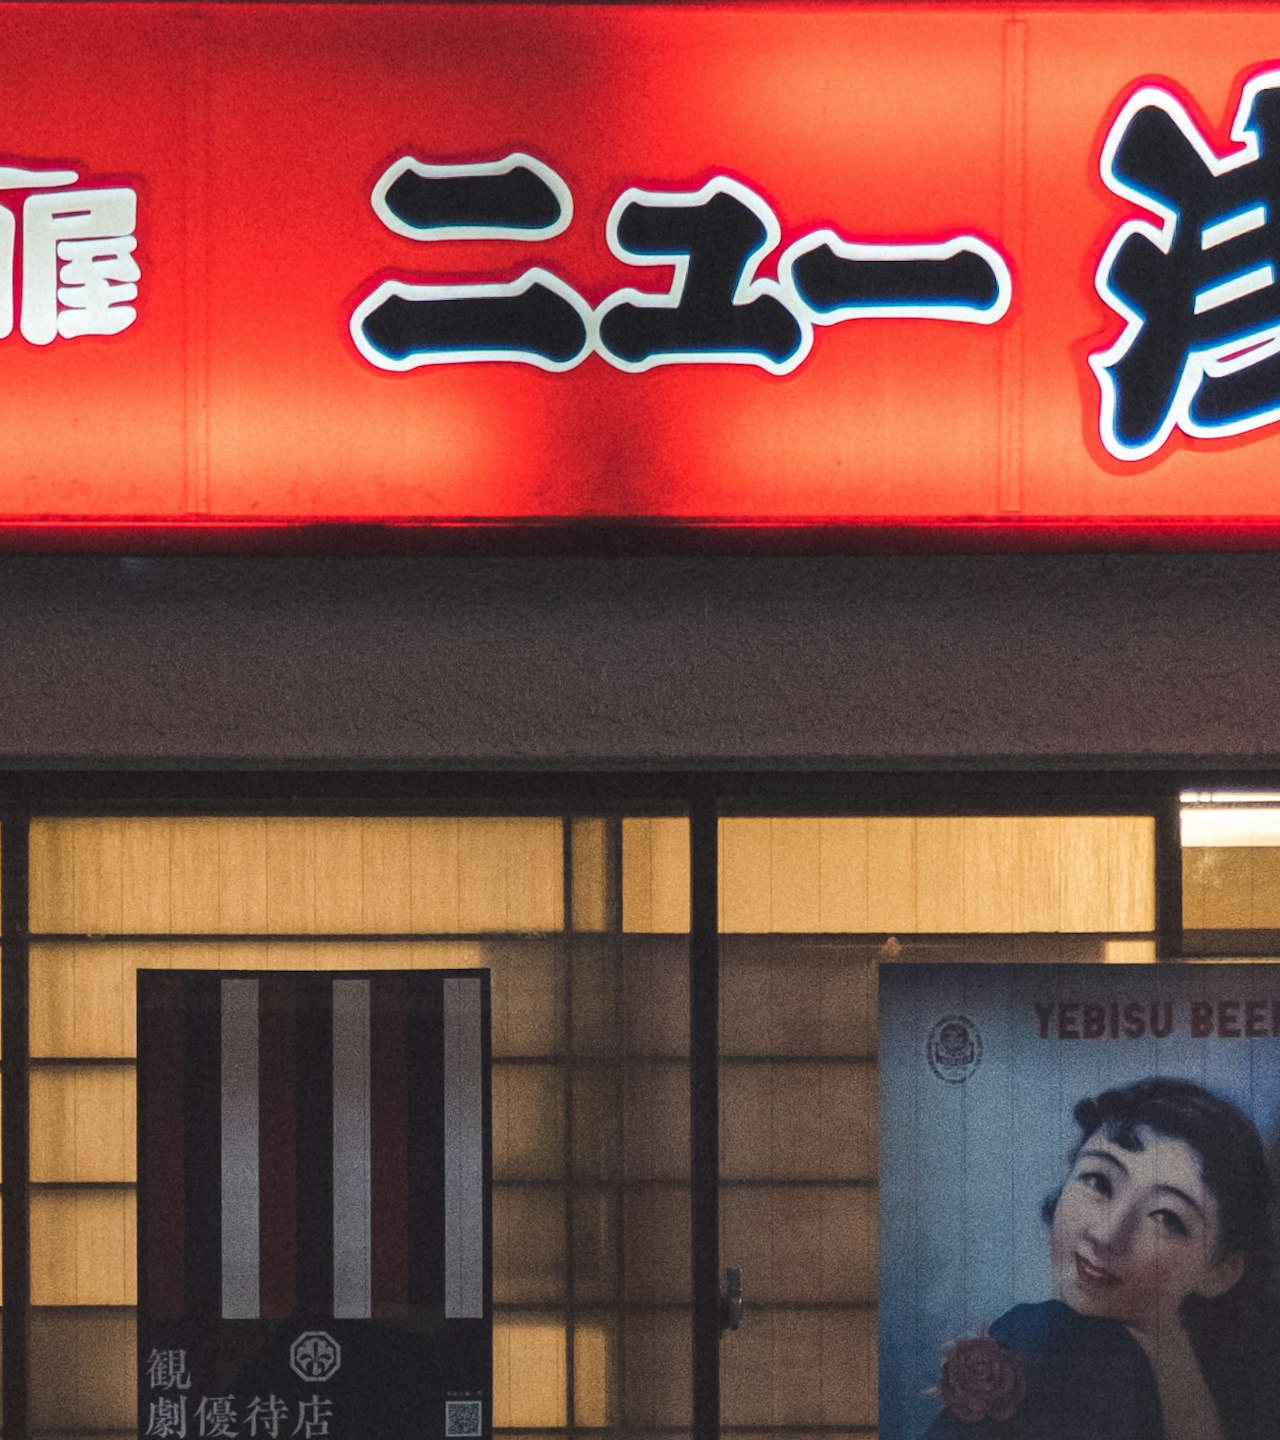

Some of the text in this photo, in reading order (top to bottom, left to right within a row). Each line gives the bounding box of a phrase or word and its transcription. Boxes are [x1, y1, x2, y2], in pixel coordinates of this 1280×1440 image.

[1034, 1002, 1173, 1039] YEBISU
[146, 1348, 191, 1391] 観
[145, 1394, 334, 1439] 劇優待店
